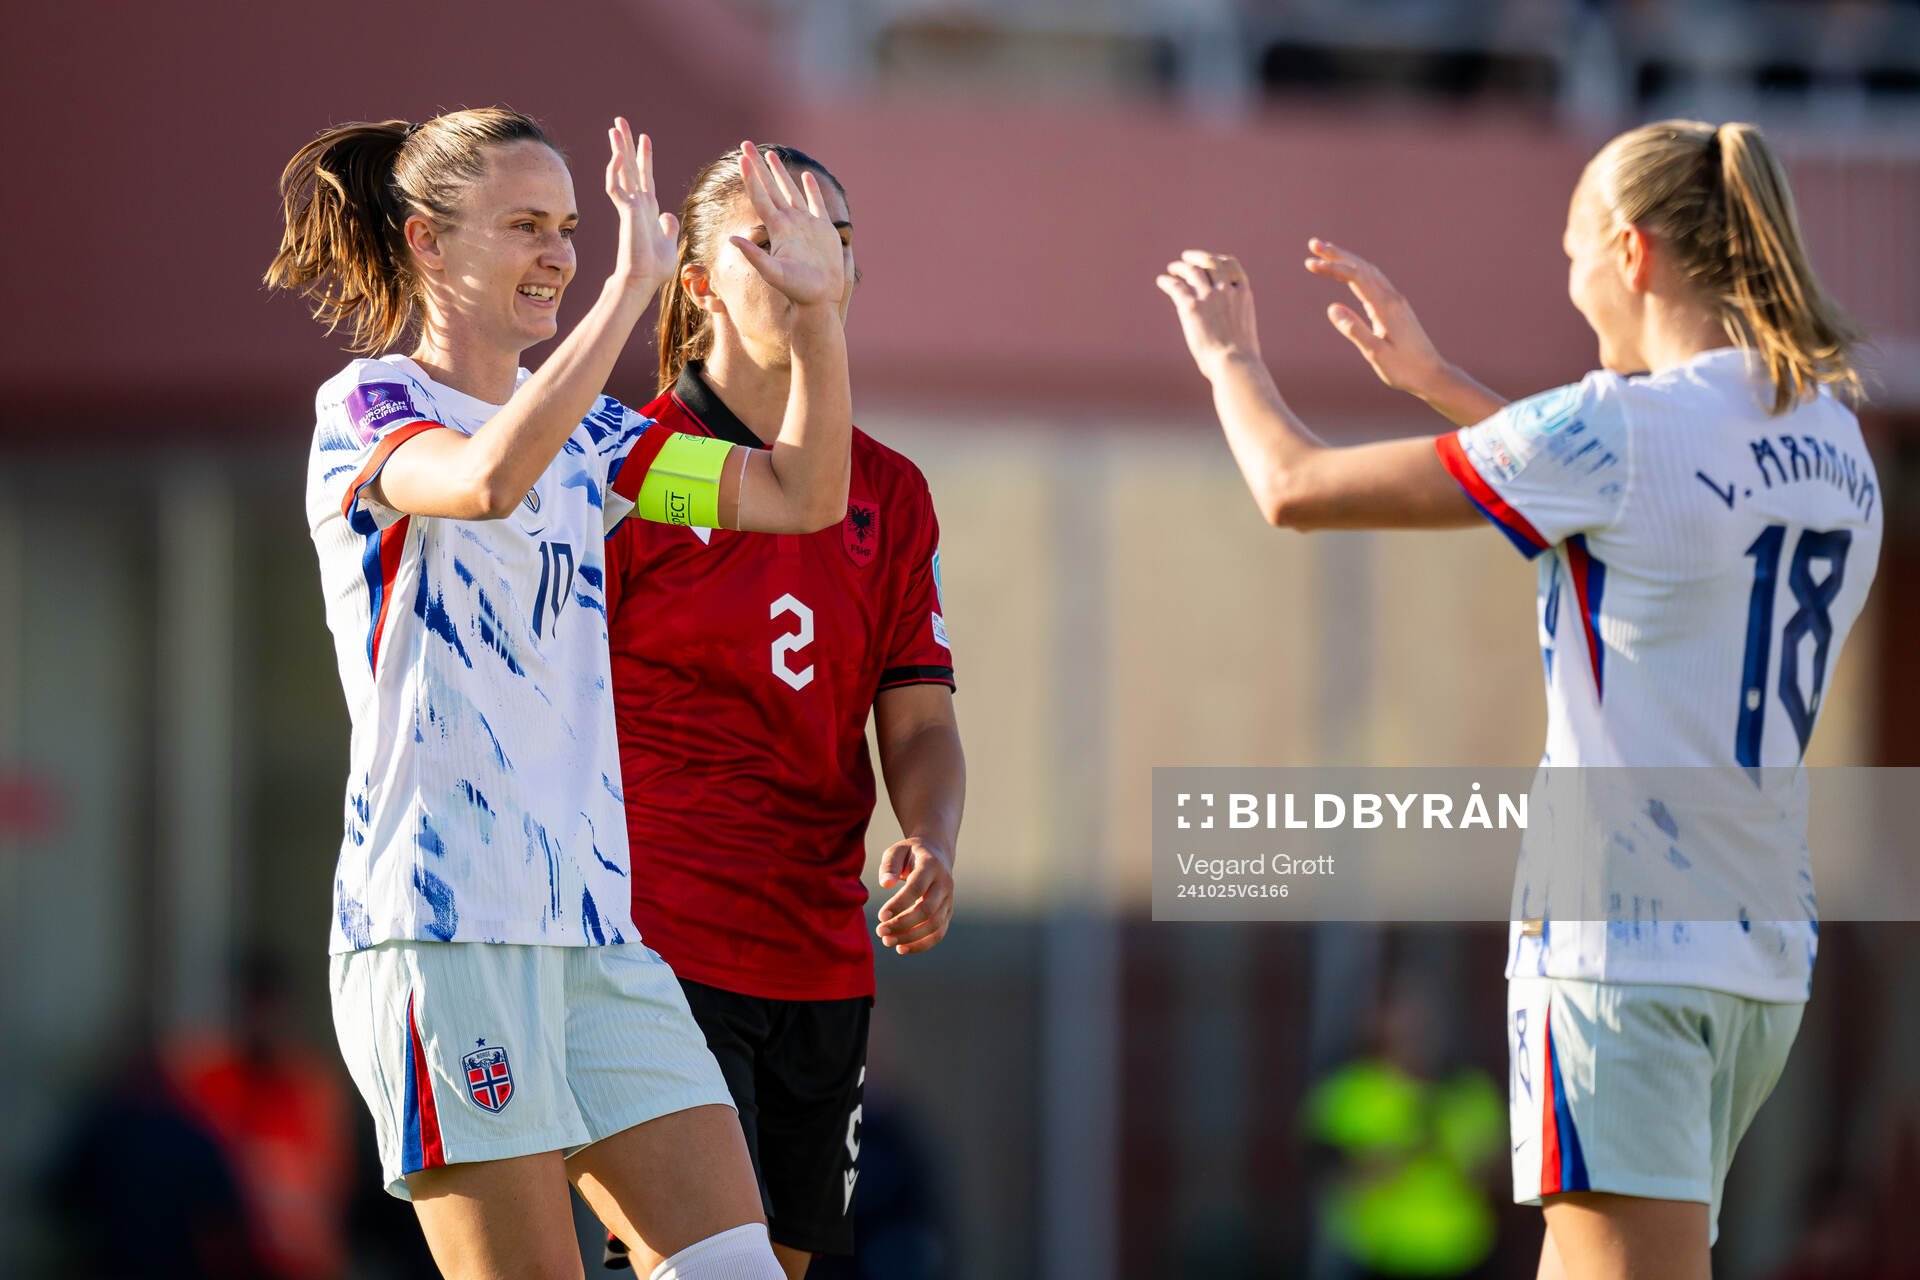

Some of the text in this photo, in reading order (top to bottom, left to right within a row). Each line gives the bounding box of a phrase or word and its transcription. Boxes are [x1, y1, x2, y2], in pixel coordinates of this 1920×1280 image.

[670, 491, 685, 525] PECT
[532, 541, 574, 640] 10
[769, 592, 814, 692] 2
[1734, 523, 1853, 792] 18
